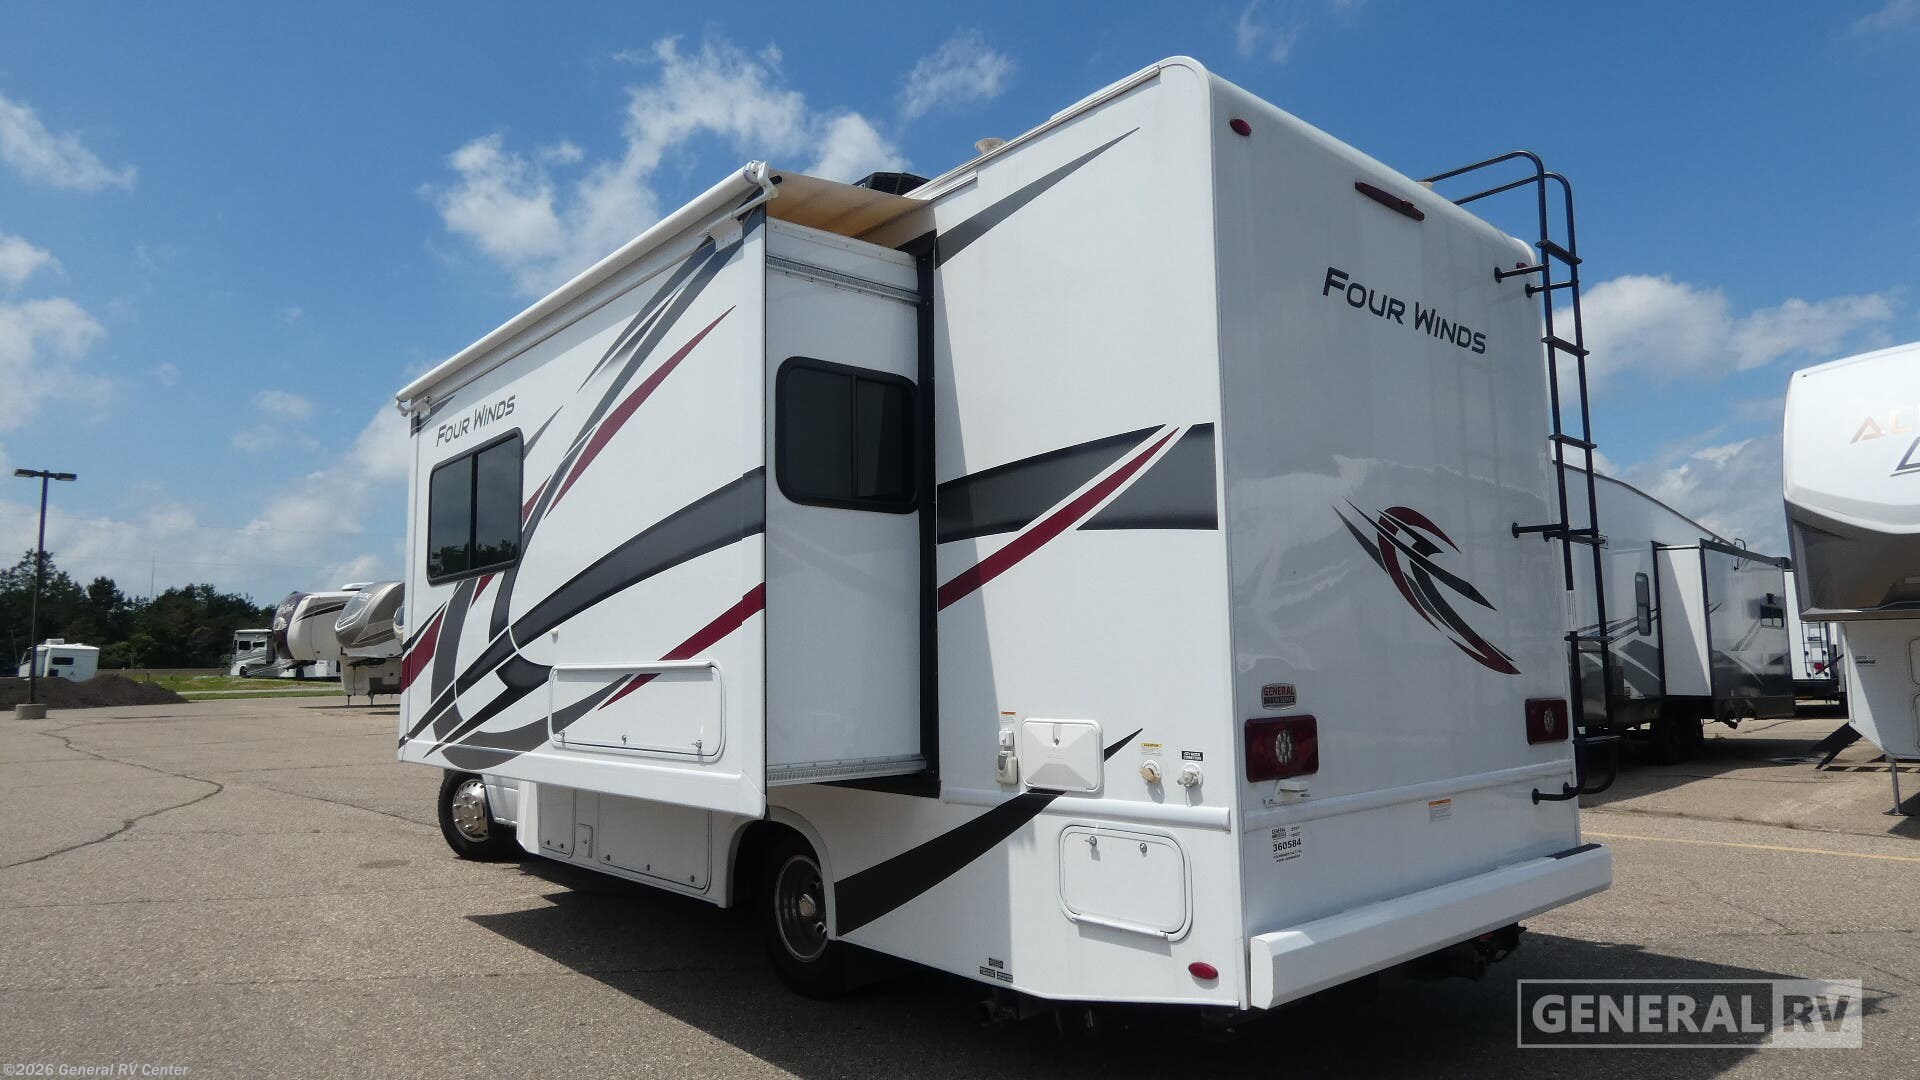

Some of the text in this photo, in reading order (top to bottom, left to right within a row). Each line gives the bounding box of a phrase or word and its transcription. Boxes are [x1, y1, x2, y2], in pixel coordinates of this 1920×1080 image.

[1322, 266, 1487, 355] FOUR WINDS
[436, 394, 516, 447] FOUR WINDS
[1272, 838, 1302, 852] 360584
